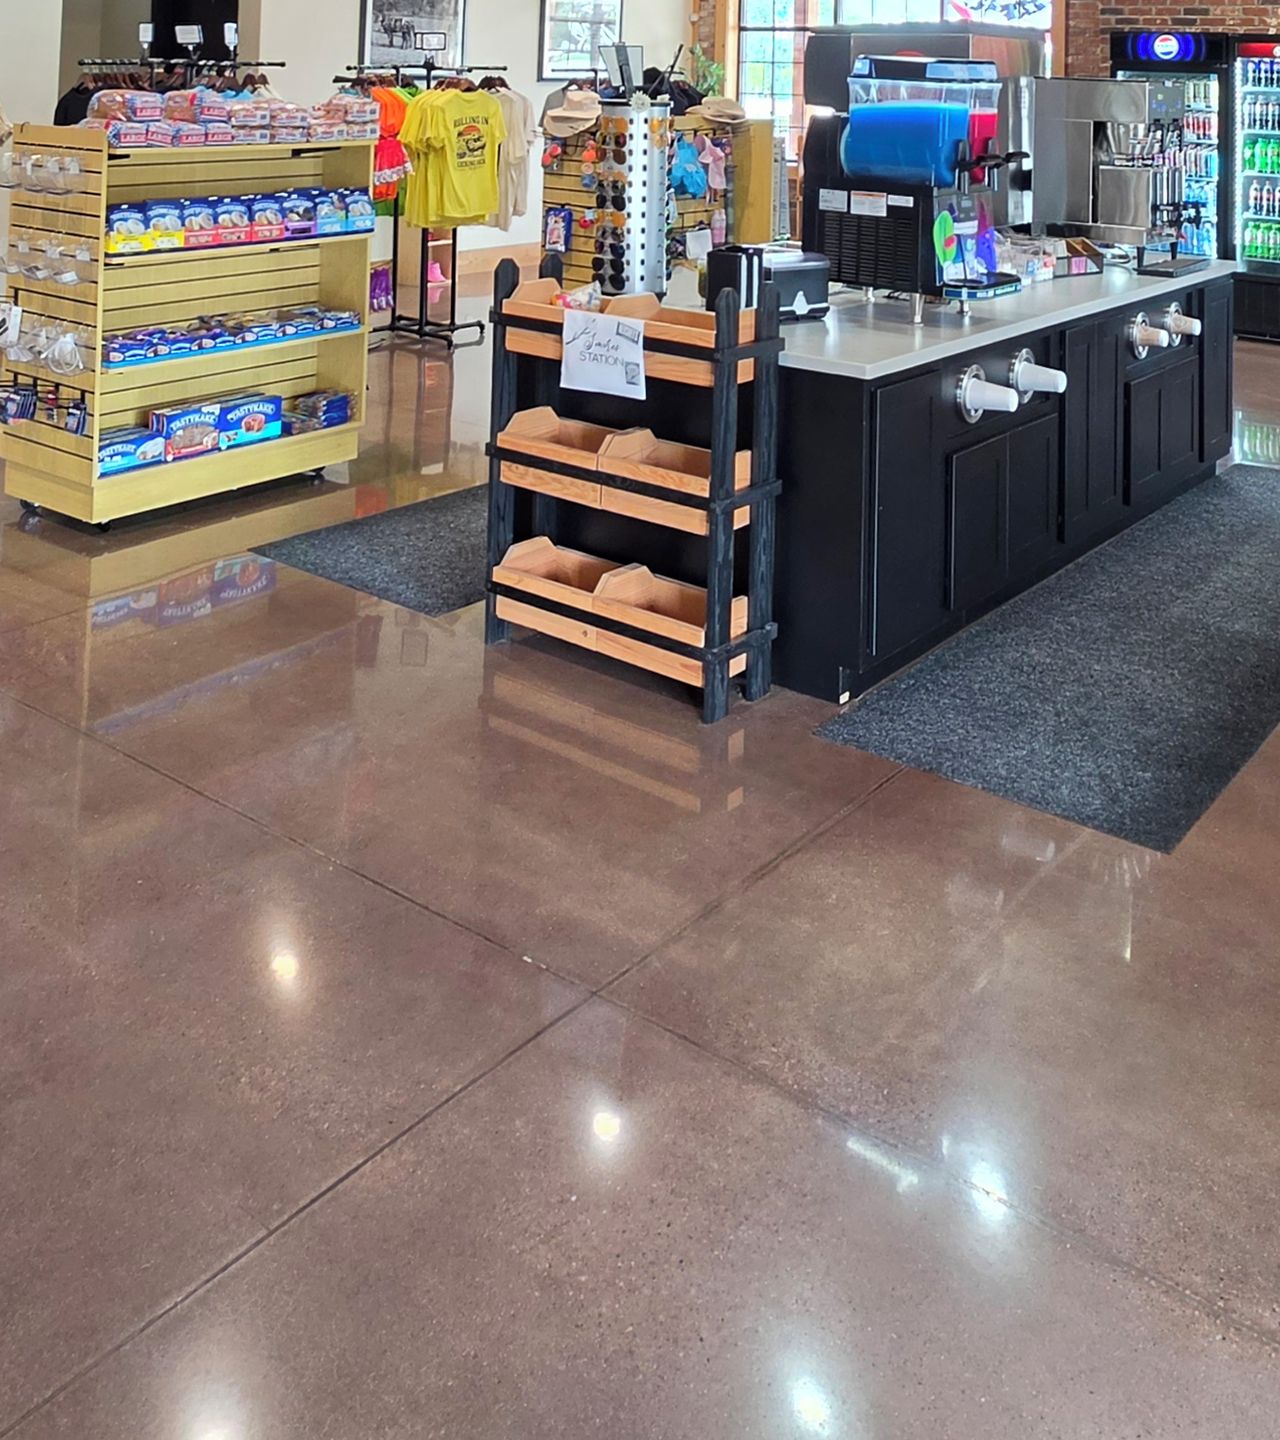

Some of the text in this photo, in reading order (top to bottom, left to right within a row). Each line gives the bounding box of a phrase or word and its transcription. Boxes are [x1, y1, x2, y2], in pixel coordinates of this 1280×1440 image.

[579, 351, 625, 367] STATION
[170, 413, 218, 431] TASTYKAKE
[227, 403, 275, 423] TASTYKAKE
